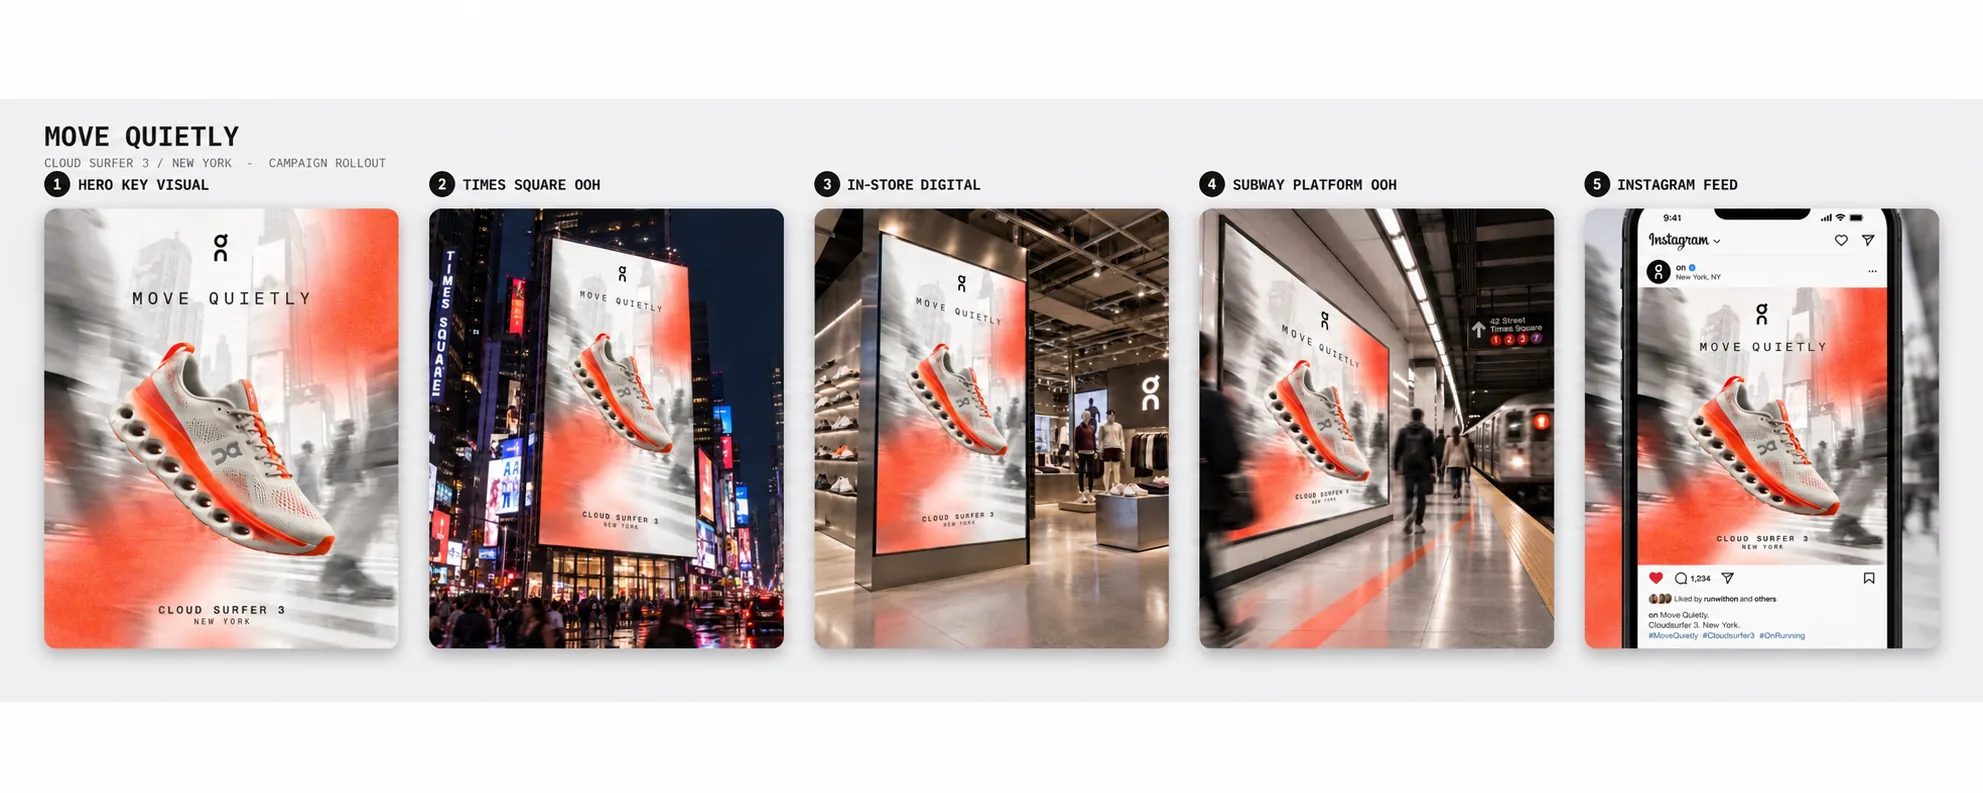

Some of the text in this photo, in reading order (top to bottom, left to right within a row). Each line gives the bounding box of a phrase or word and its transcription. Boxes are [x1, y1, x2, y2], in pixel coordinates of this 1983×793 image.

[1663, 213, 1681, 222] 9:41
[1648, 232, 1710, 251] Instagram
[442, 251, 455, 309] TIMES
[133, 292, 309, 305] MOVE QUIETLY
[580, 291, 662, 312] MOVE QUIETLY
[915, 297, 1001, 325] MOVE QUIETLY
[1282, 325, 1360, 369] MOVE QUIETLY
[1700, 342, 1826, 352] MOVE QUIETLY
[582, 511, 610, 519] CLOUD
[1691, 575, 1710, 583] 1,234
[1694, 596, 1702, 604] by
[159, 606, 284, 614] CLOUD SURFER 3
[1649, 632, 1698, 640] #MoveQuietly
[1760, 632, 1805, 640] #OnRunning
